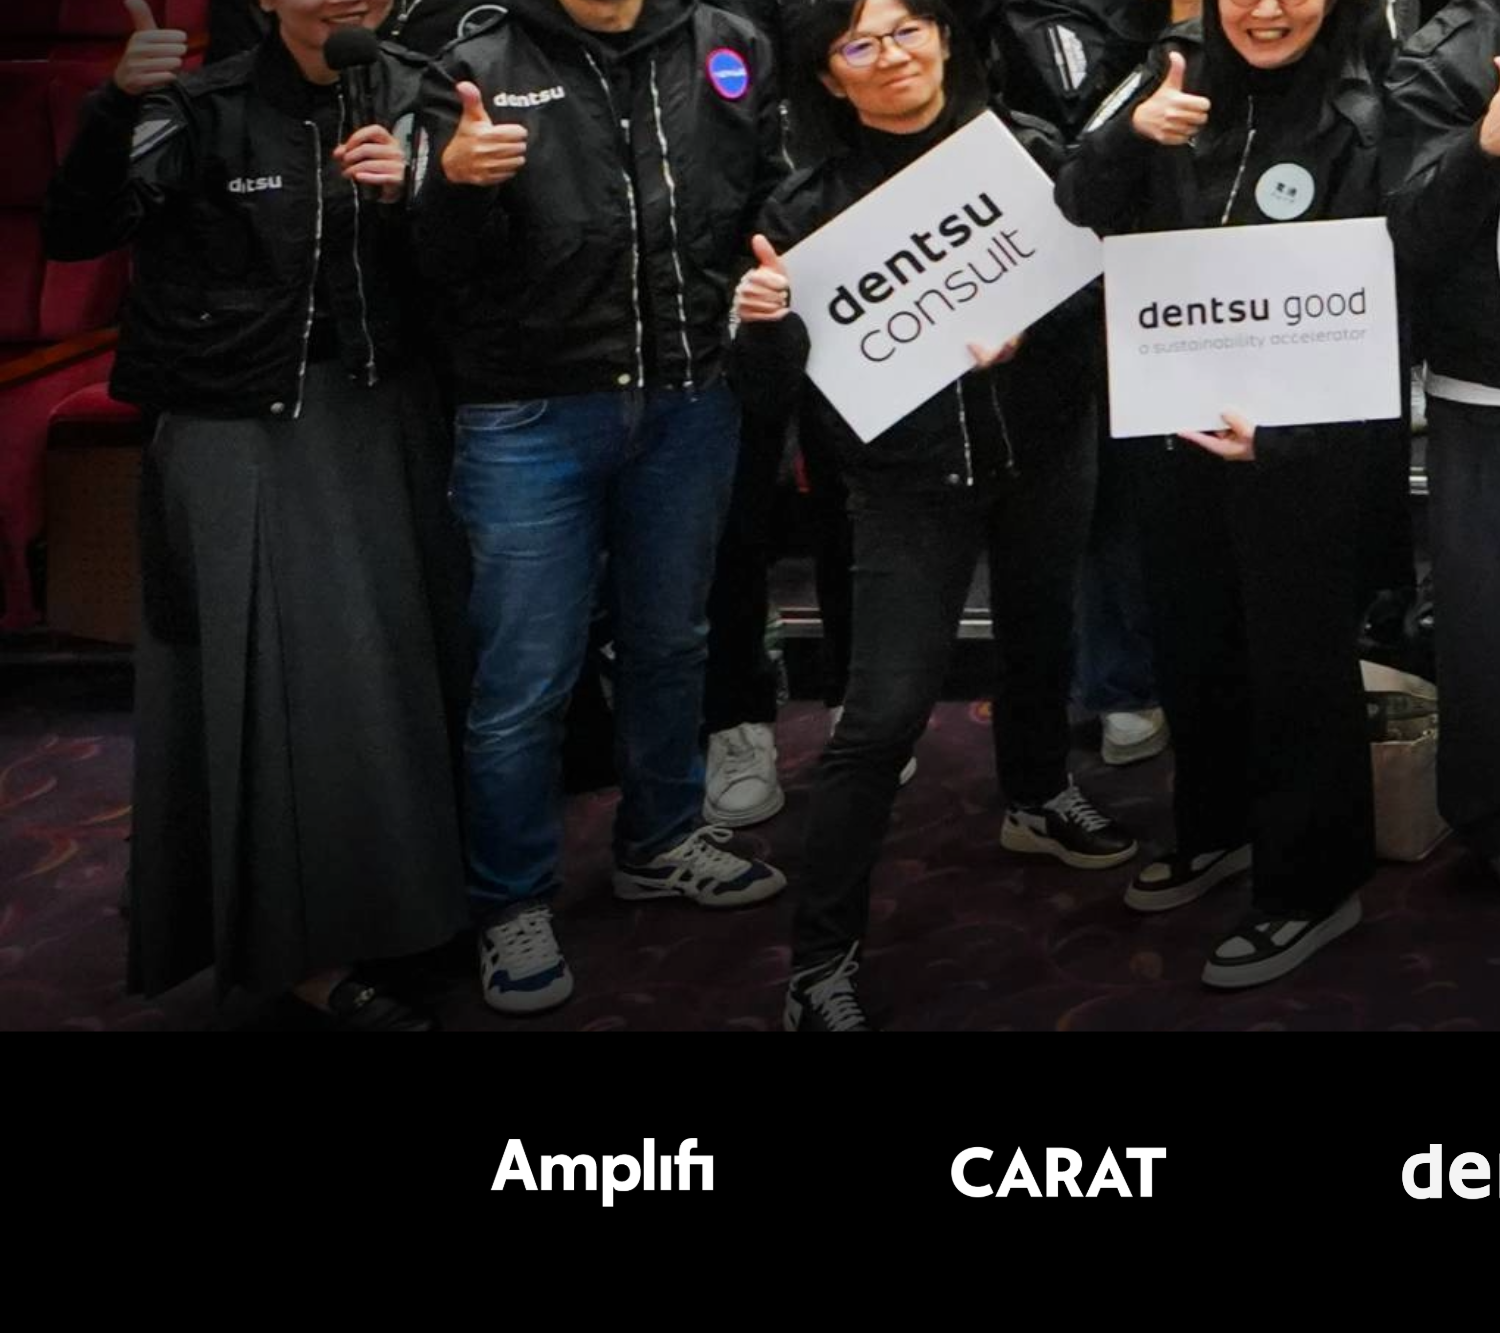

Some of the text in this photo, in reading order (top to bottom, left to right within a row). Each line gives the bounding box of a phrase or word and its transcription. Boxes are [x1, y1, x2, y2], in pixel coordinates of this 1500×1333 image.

[494, 85, 565, 108] dentsu
[828, 191, 1004, 326] dentsu
[859, 223, 1037, 364] consult
[1138, 287, 1367, 329] dentsu good
[1138, 328, 1368, 356] a sustainability accelerator
